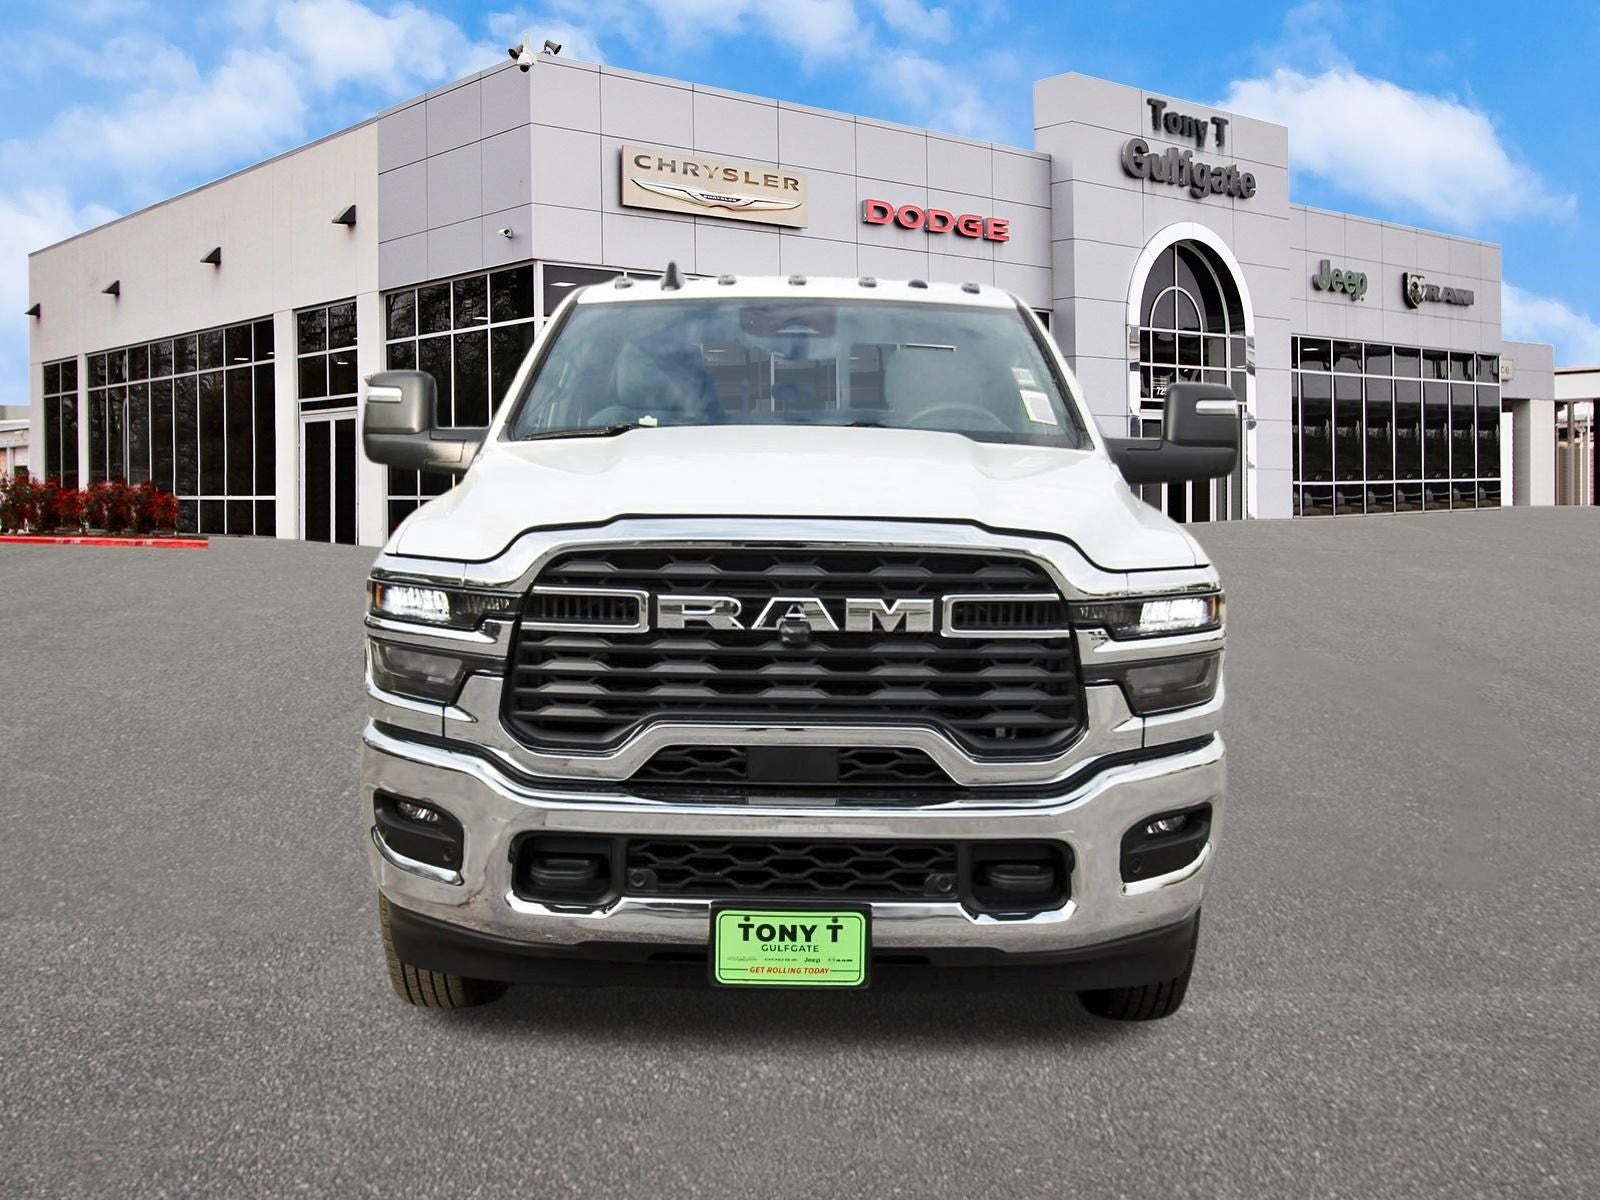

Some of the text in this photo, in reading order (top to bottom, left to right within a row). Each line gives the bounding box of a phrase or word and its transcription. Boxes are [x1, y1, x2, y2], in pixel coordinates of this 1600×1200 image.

[1147, 98, 1229, 147] Tony T
[633, 154, 800, 192] CHRYSLER
[1121, 138, 1256, 199] Gulfgate
[862, 198, 1011, 242] DODGE
[1312, 259, 1368, 301] Jeep
[1425, 283, 1475, 307] RAM
[657, 594, 934, 632] RAM
[738, 916, 843, 943] TONY T
[761, 943, 820, 953] GULFGATE
[750, 966, 829, 975] GET ROLLING TODAY
